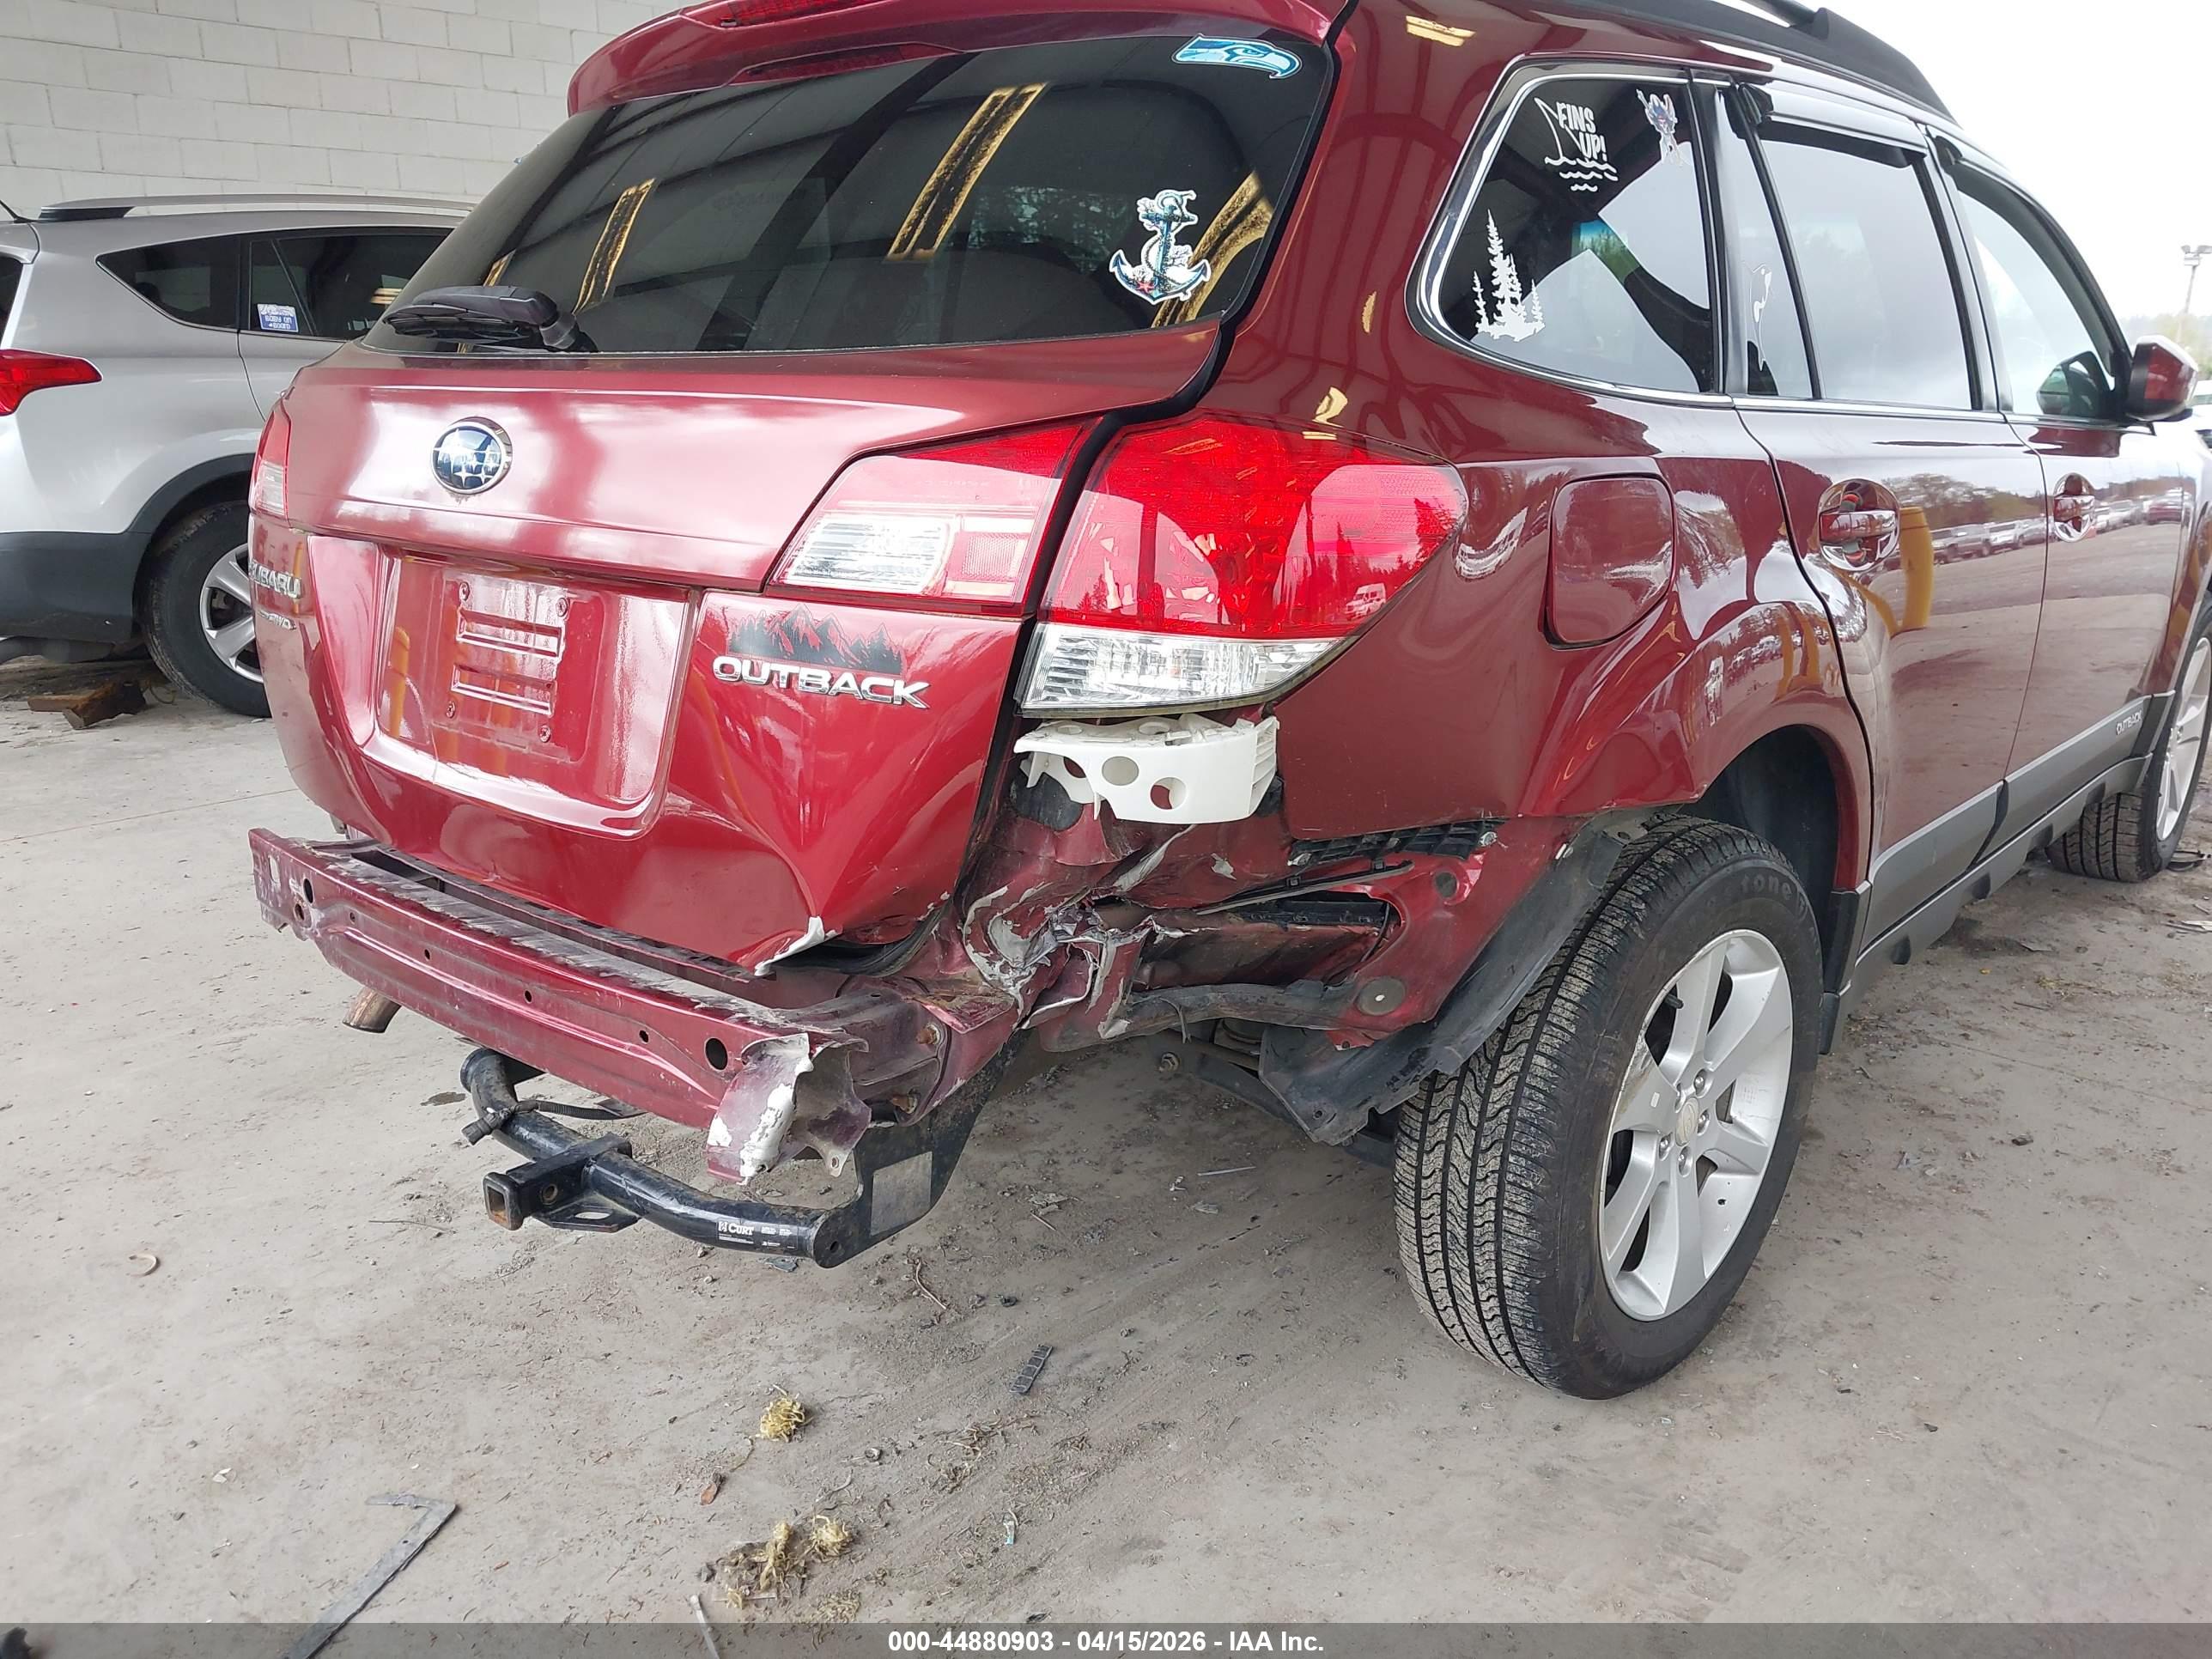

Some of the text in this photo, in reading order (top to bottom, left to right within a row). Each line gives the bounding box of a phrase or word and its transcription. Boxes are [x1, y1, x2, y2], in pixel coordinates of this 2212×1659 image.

[1556, 101, 1596, 134] FINS
[1578, 131, 1607, 162] UP!
[712, 655, 930, 710] OUTBACK
[727, 1222, 755, 1236] CURT
